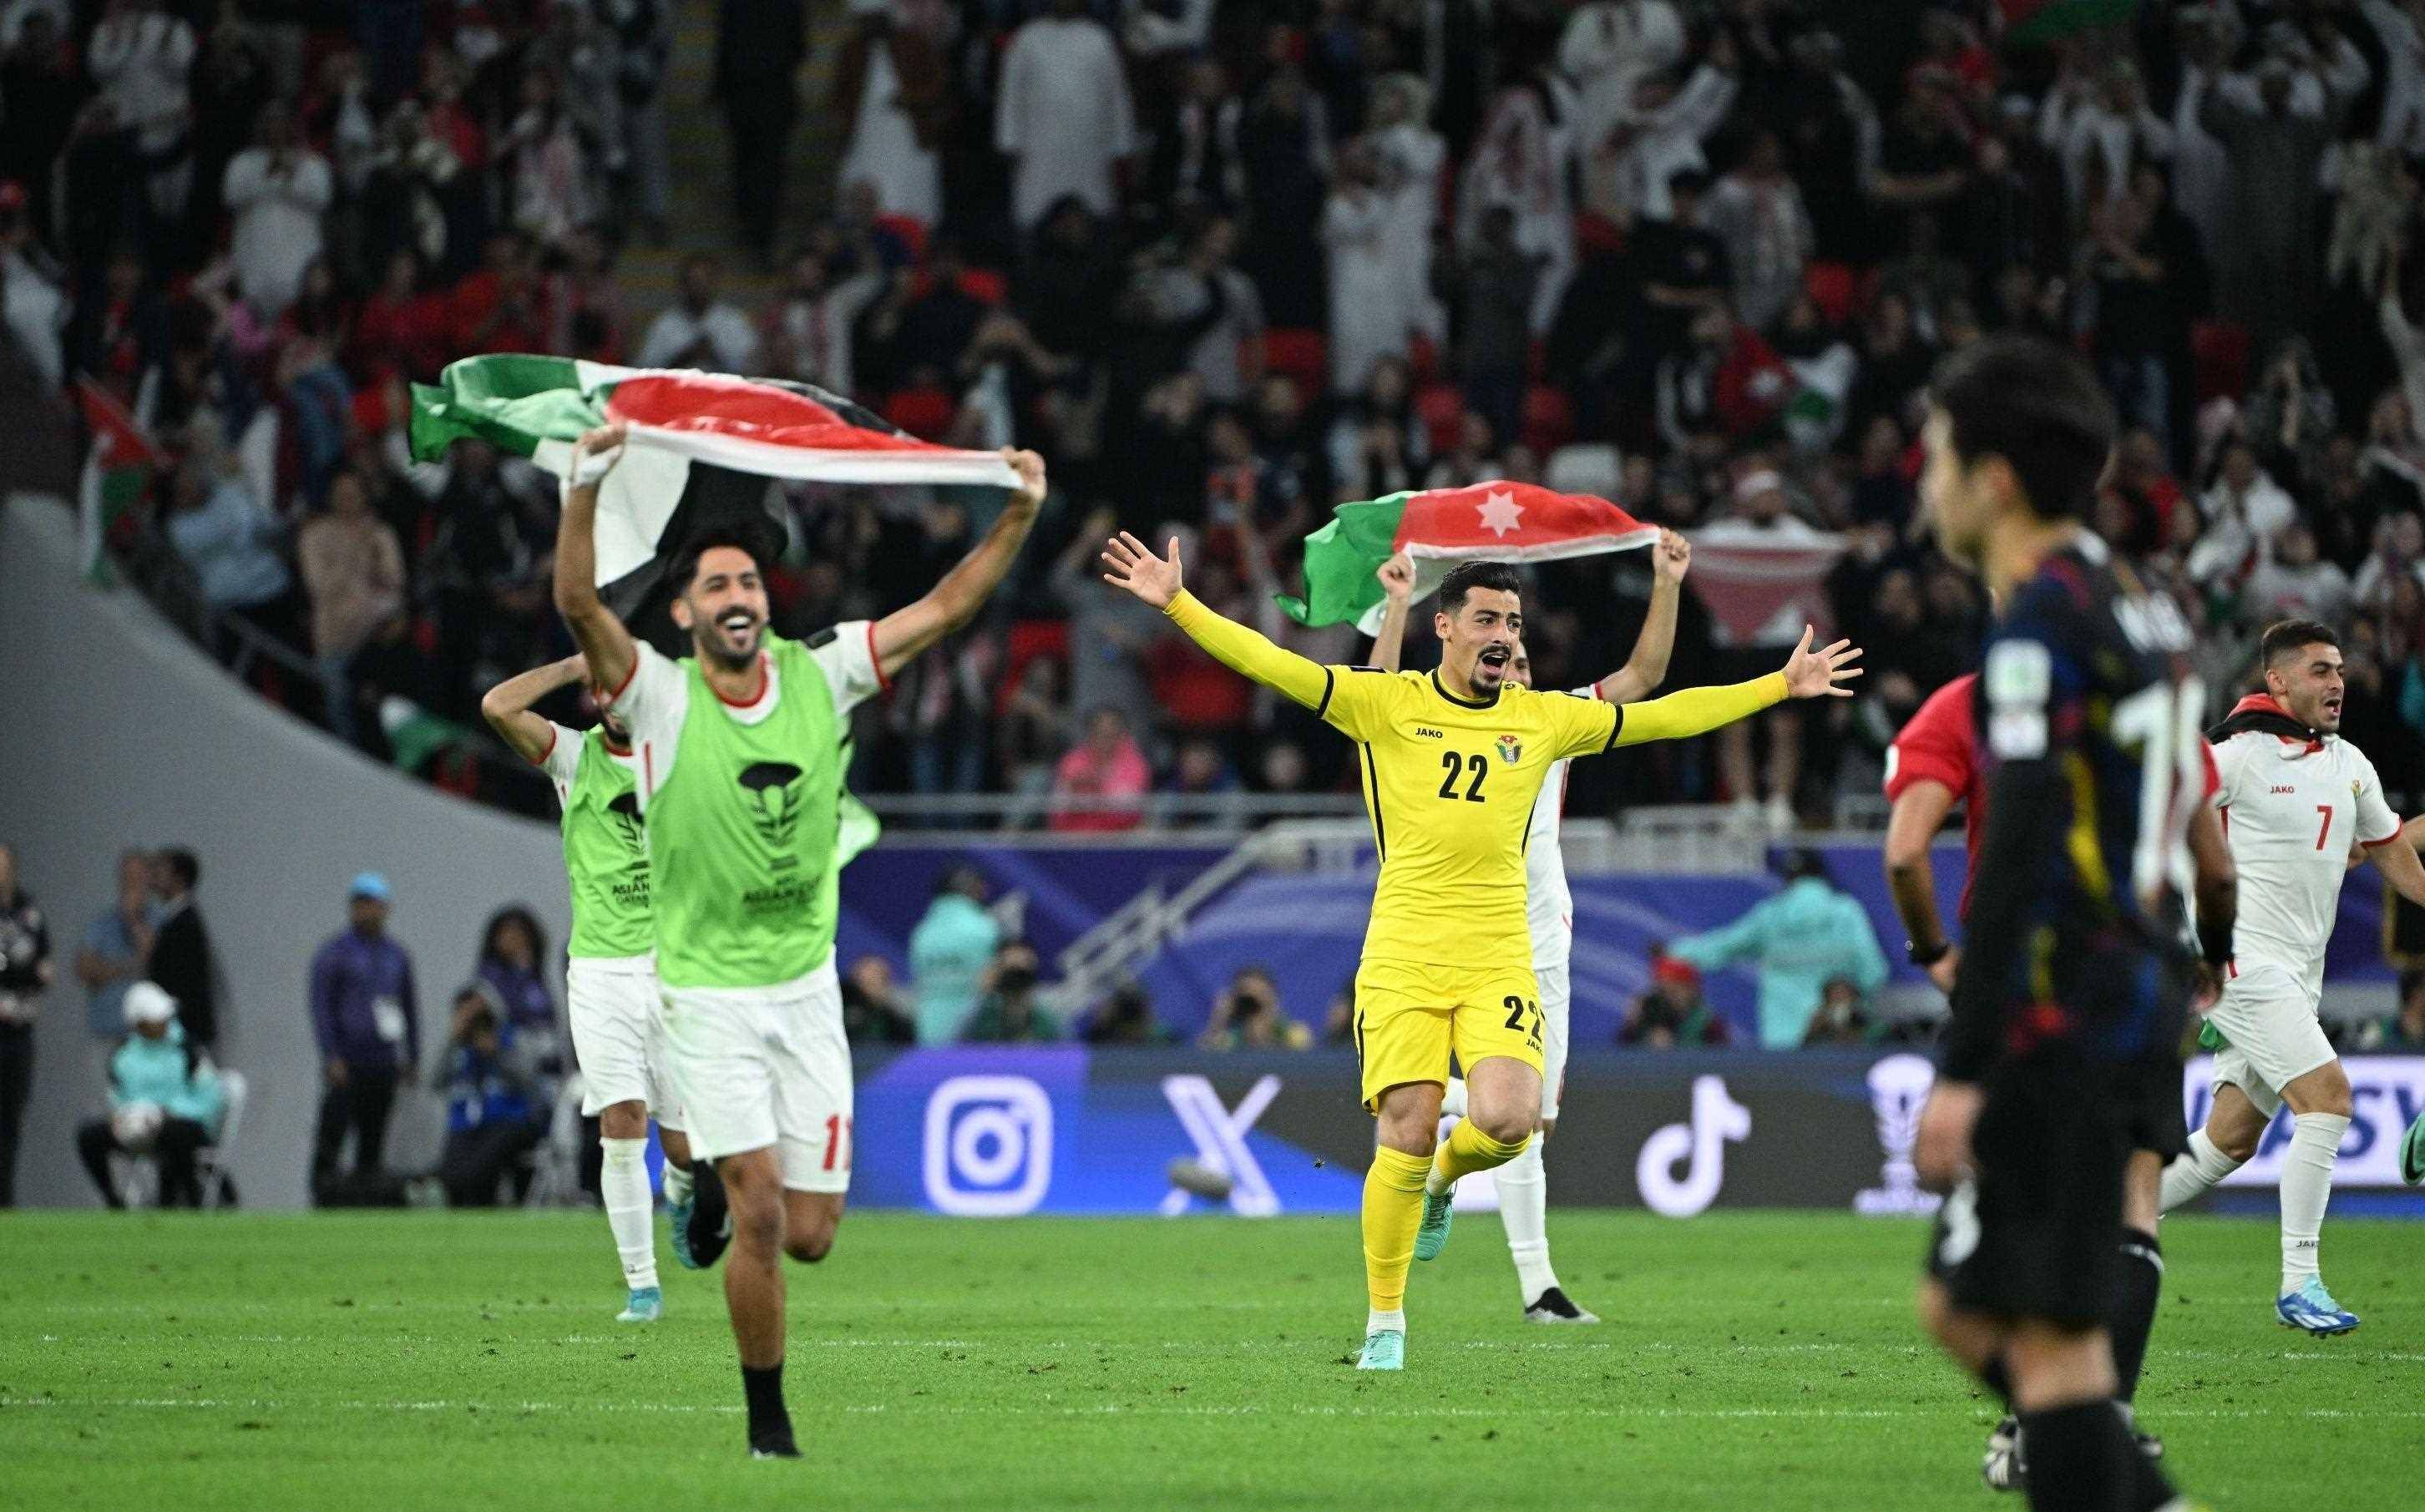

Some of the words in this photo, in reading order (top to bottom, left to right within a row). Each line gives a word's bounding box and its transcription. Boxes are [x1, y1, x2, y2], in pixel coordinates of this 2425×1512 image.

[1415, 727, 1444, 739] JAKO
[1438, 751, 1488, 803] 22
[2270, 786, 2295, 794] JAKO
[2316, 805, 2333, 851] 7
[1503, 995, 1546, 1044] 22
